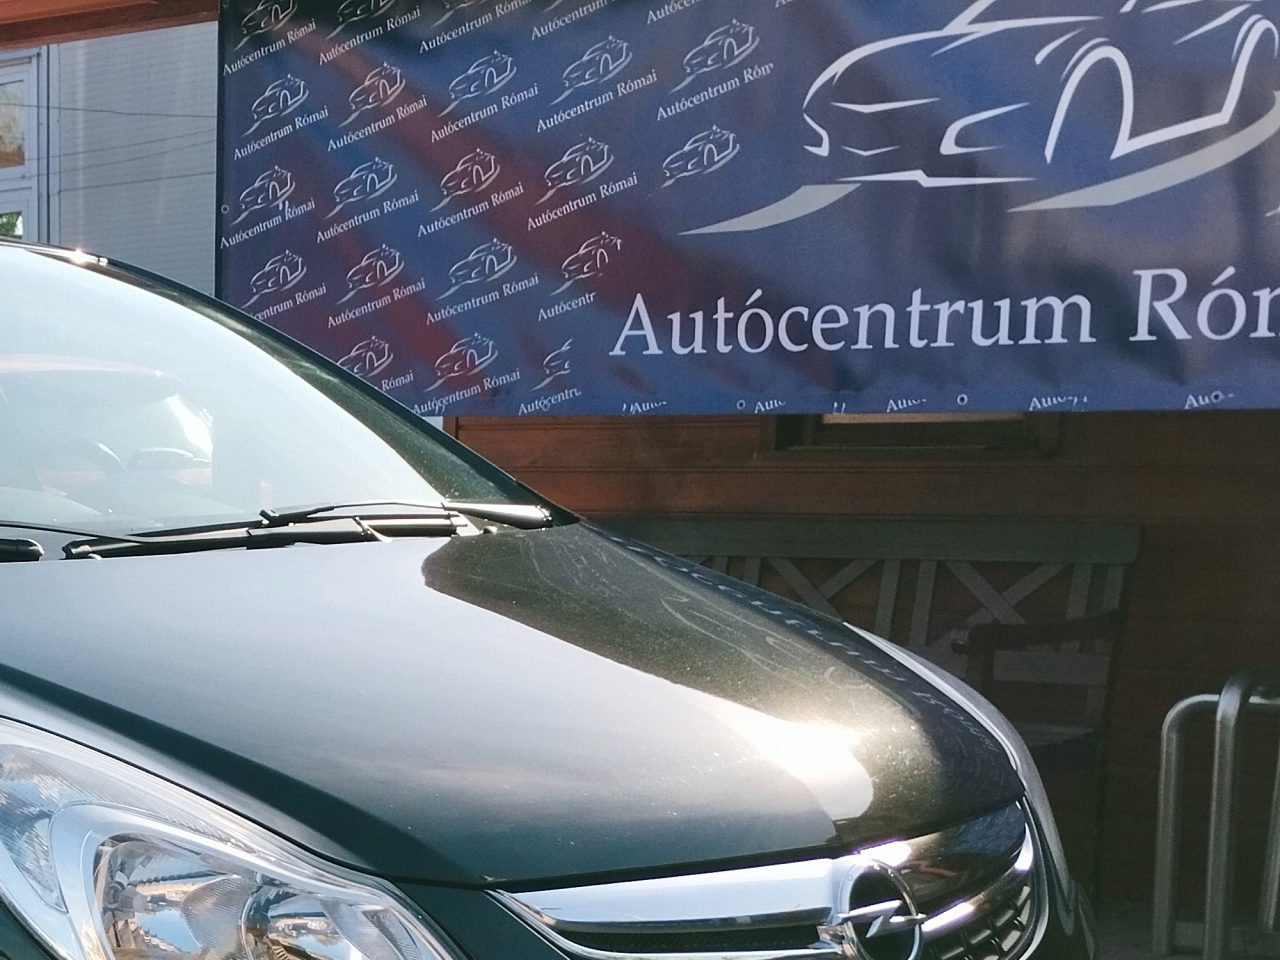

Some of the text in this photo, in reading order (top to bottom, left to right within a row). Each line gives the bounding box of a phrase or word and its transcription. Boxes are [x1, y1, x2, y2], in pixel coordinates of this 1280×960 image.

[222, 18, 316, 76] Autócentrum Római
[319, 5, 421, 66] Autócentrum Római
[419, 13, 493, 53] Autócentrum
[327, 94, 428, 152] Autócentrum Római
[430, 83, 539, 143] Autócentrum Római
[536, 68, 658, 133] Autócentrum Római
[656, 76, 740, 121] Autócentrum
[233, 105, 329, 161] Autócentrum Római
[316, 189, 420, 244] Autócentrum Római
[417, 181, 525, 237] Autócentrum Római
[527, 171, 639, 231] Autócentrum Római
[220, 211, 283, 249] Autócentrum
[250, 282, 327, 320] centrum Római
[327, 276, 426, 329] Autócentrum Római
[425, 272, 540, 326] Autócentrum Római
[609, 287, 1096, 355] Autócentrum
[381, 369, 414, 392] Római
[483, 367, 520, 391] Római
